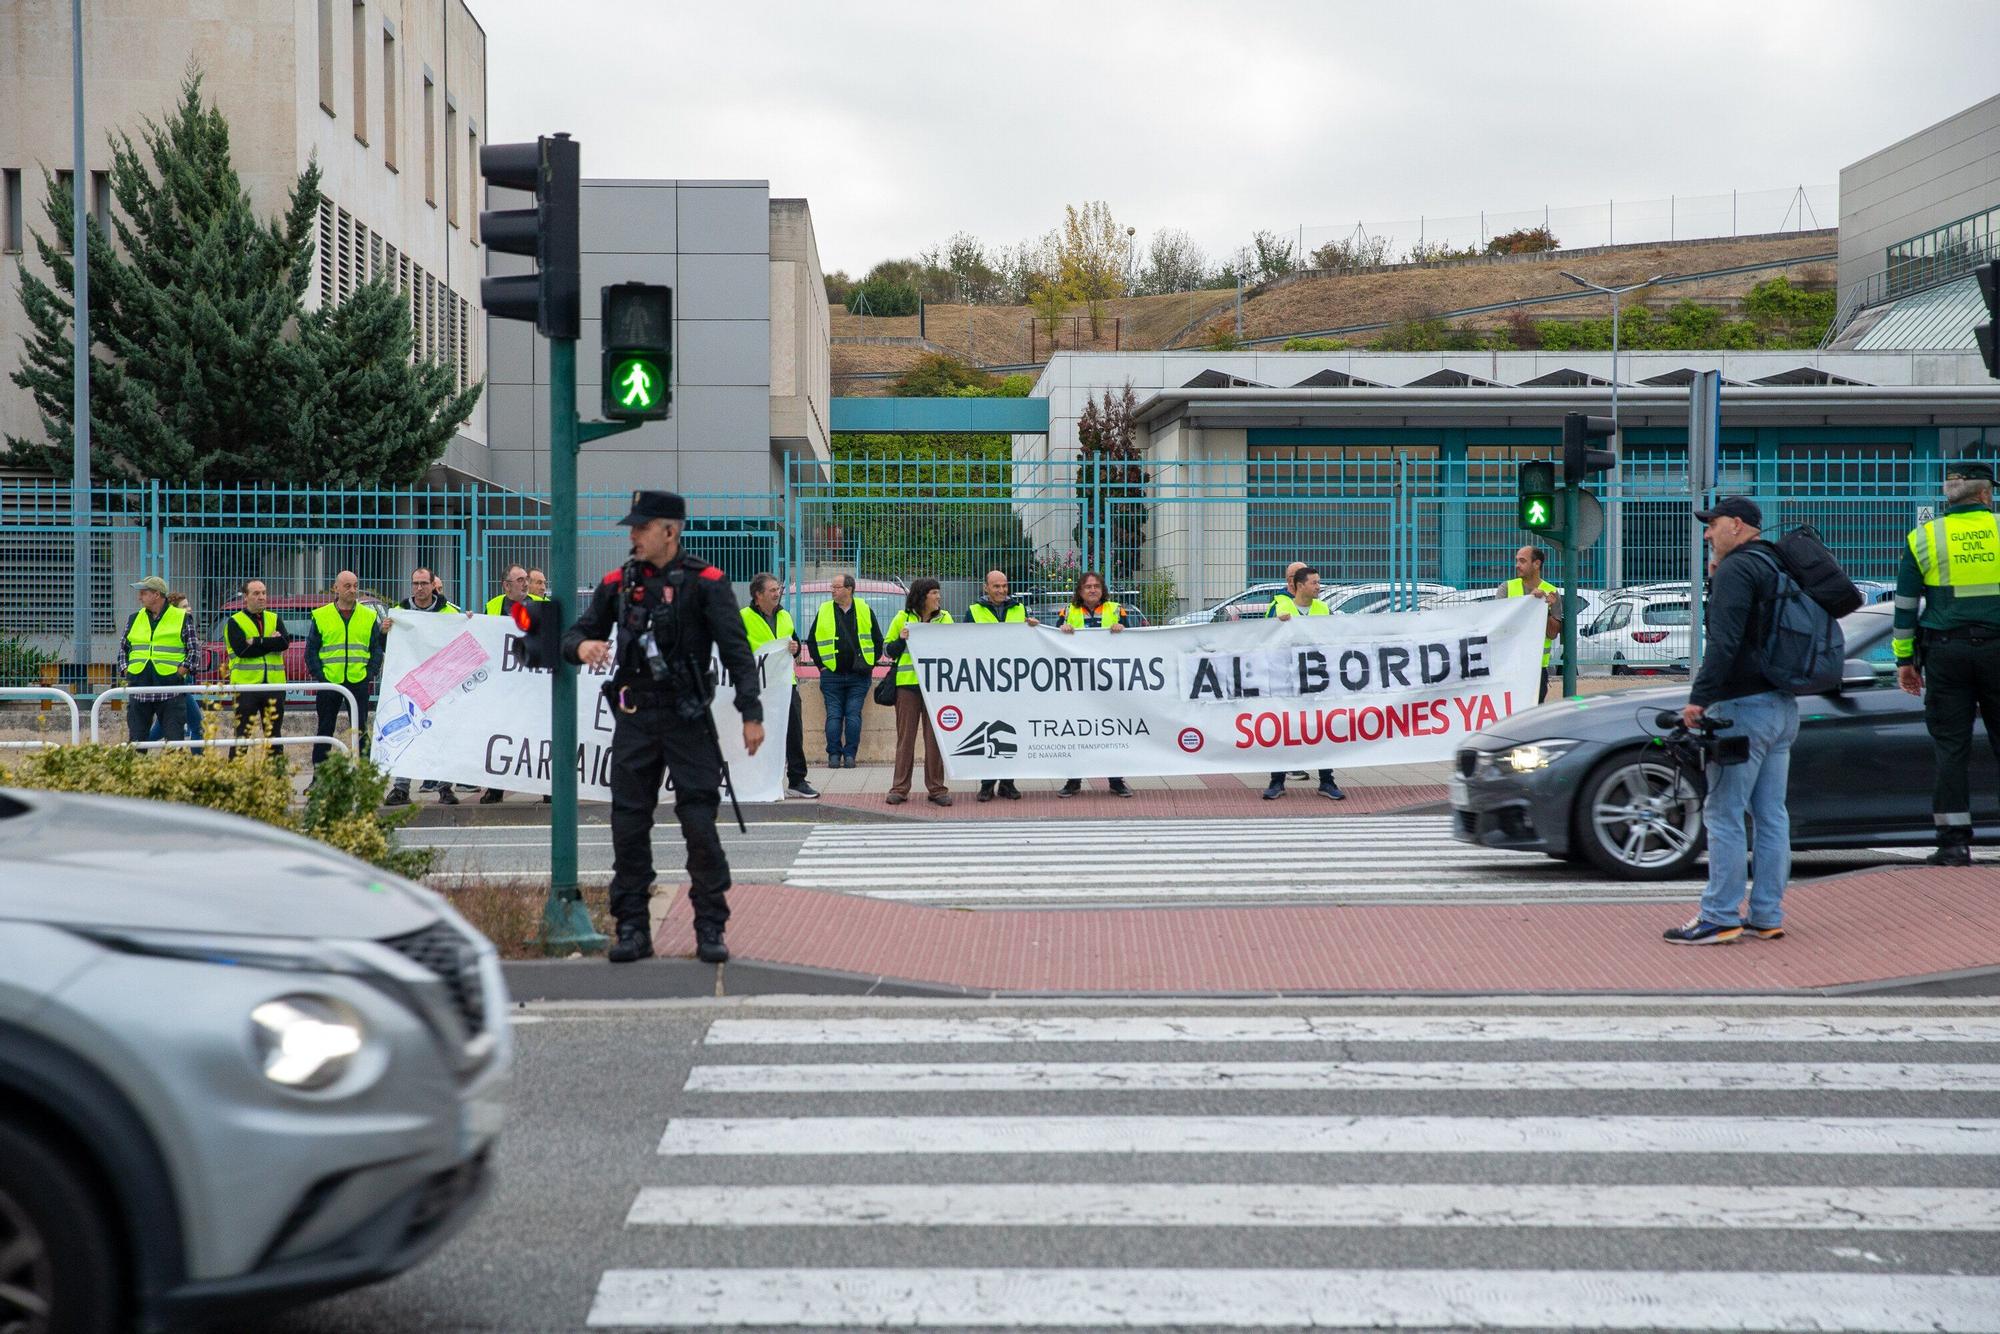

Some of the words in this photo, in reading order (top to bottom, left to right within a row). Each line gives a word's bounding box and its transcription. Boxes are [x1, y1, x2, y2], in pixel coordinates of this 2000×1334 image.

[1951, 529, 1995, 541] GUARDIA
[1962, 541, 1985, 550] CIVIL
[918, 657, 1165, 692] TRANSPORTISTAS
[1189, 656, 1260, 699] AL
[1298, 635, 1490, 695] BORDE
[1235, 699, 1450, 749] SOLUCIONES
[1077, 742, 1129, 750] TRANSPORTISTAS
